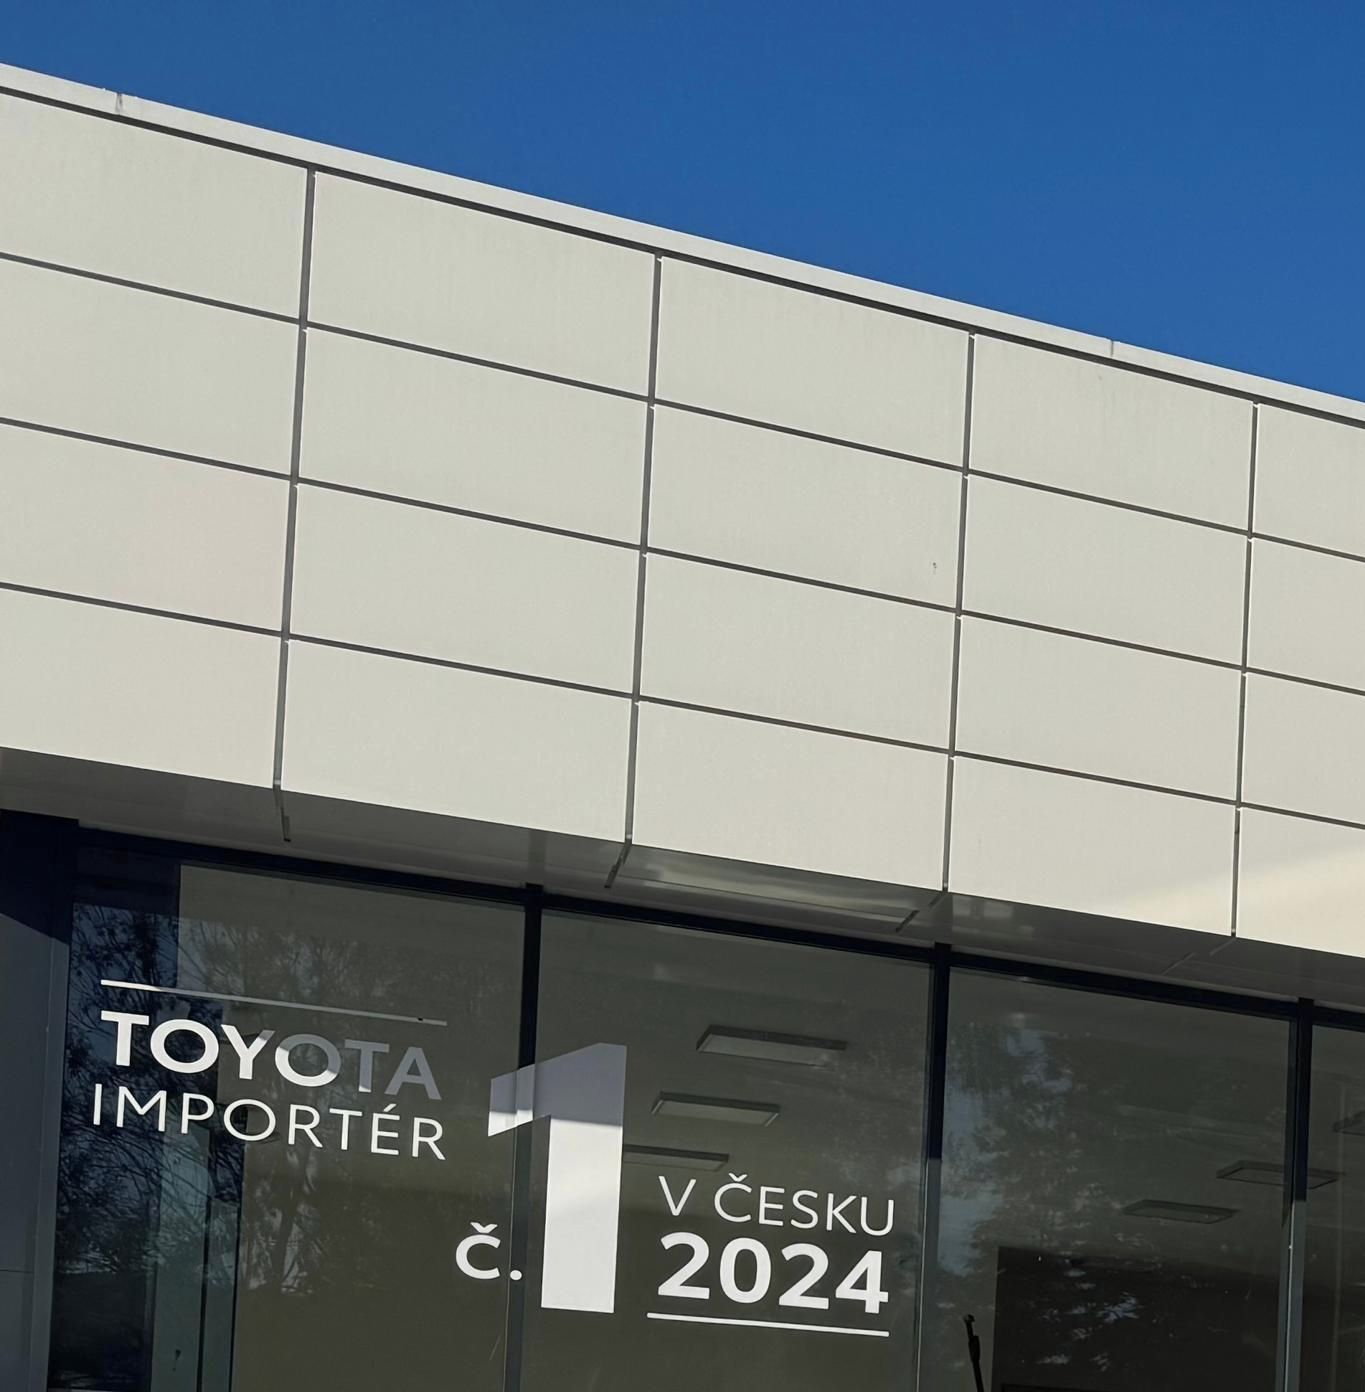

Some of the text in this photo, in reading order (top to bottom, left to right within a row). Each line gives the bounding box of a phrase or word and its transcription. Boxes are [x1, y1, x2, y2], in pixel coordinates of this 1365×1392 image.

[101, 1010, 442, 1100] TOYOTA
[93, 1083, 446, 1160] IMPORTÉR
[658, 1172, 895, 1236] V ČESKU
[658, 1232, 889, 1314] 2024
